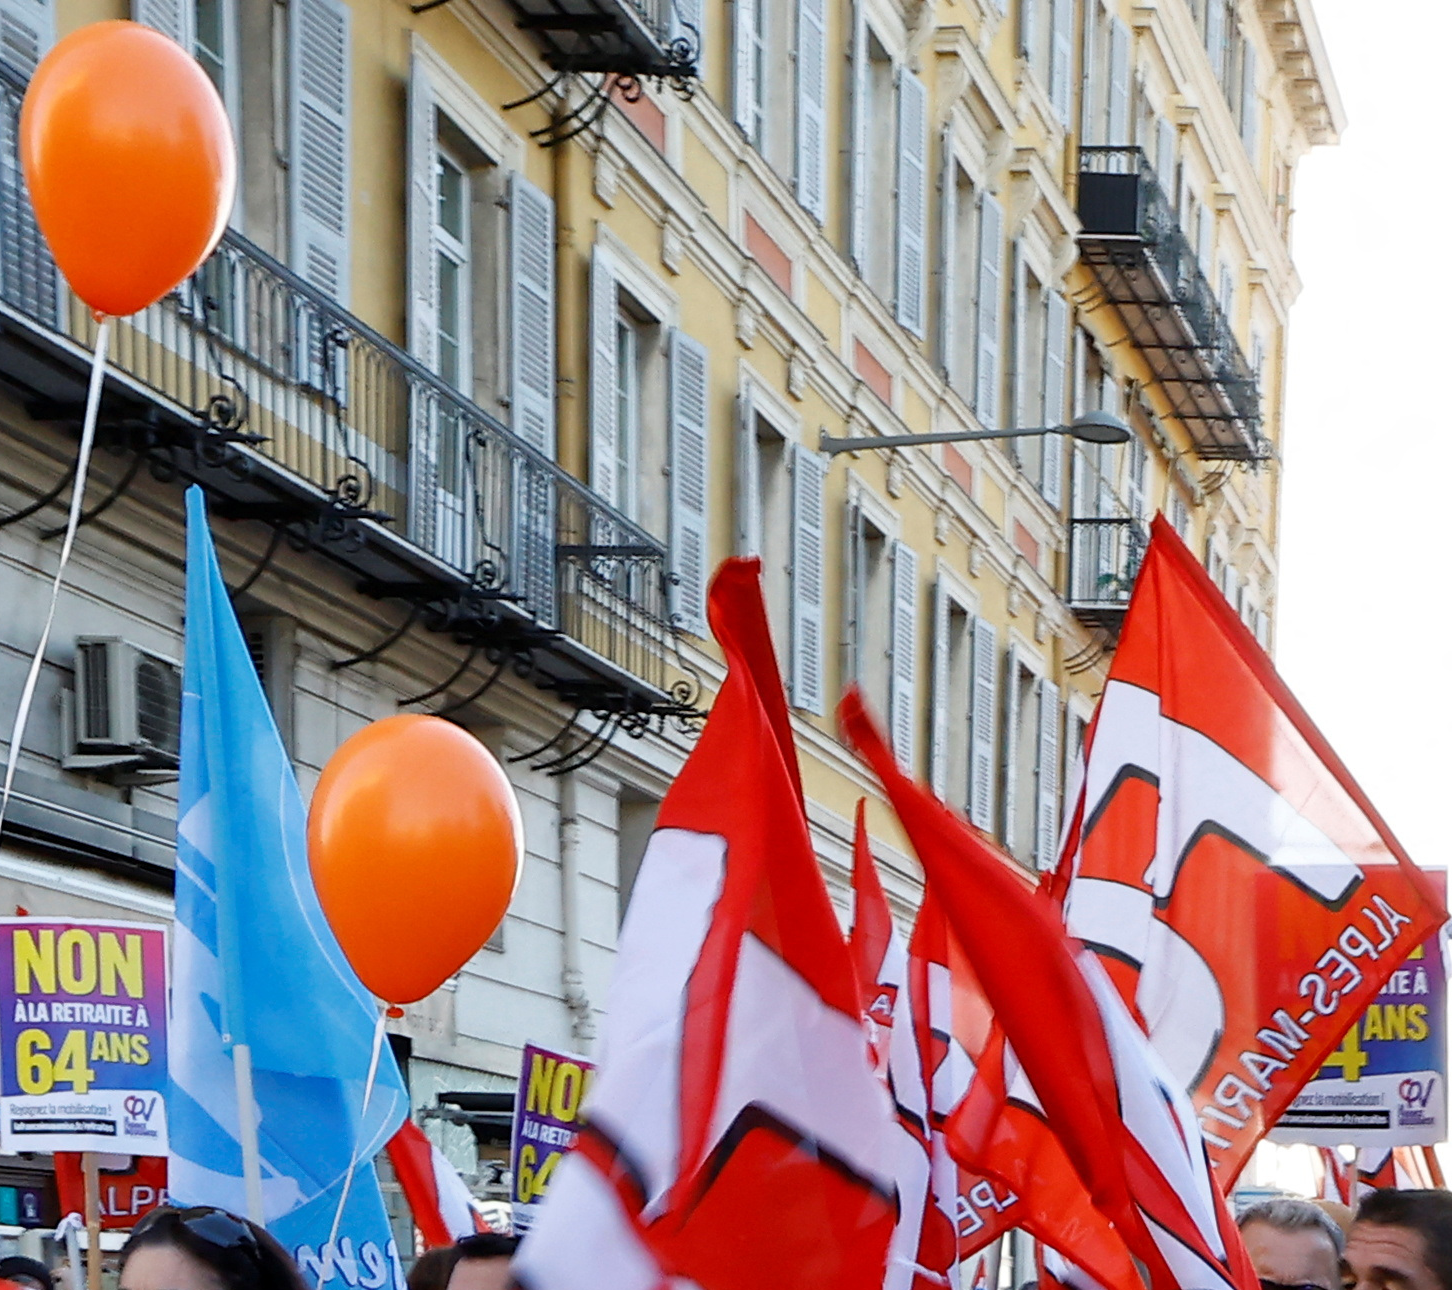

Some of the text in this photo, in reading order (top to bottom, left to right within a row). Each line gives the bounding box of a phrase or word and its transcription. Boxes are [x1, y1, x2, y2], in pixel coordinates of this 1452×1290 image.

[13, 928, 144, 999] NON
[14, 999, 150, 1028] À LA RETRAITE À
[1363, 1003, 1431, 1042] ANS
[16, 1028, 151, 1096] 64 ANS
